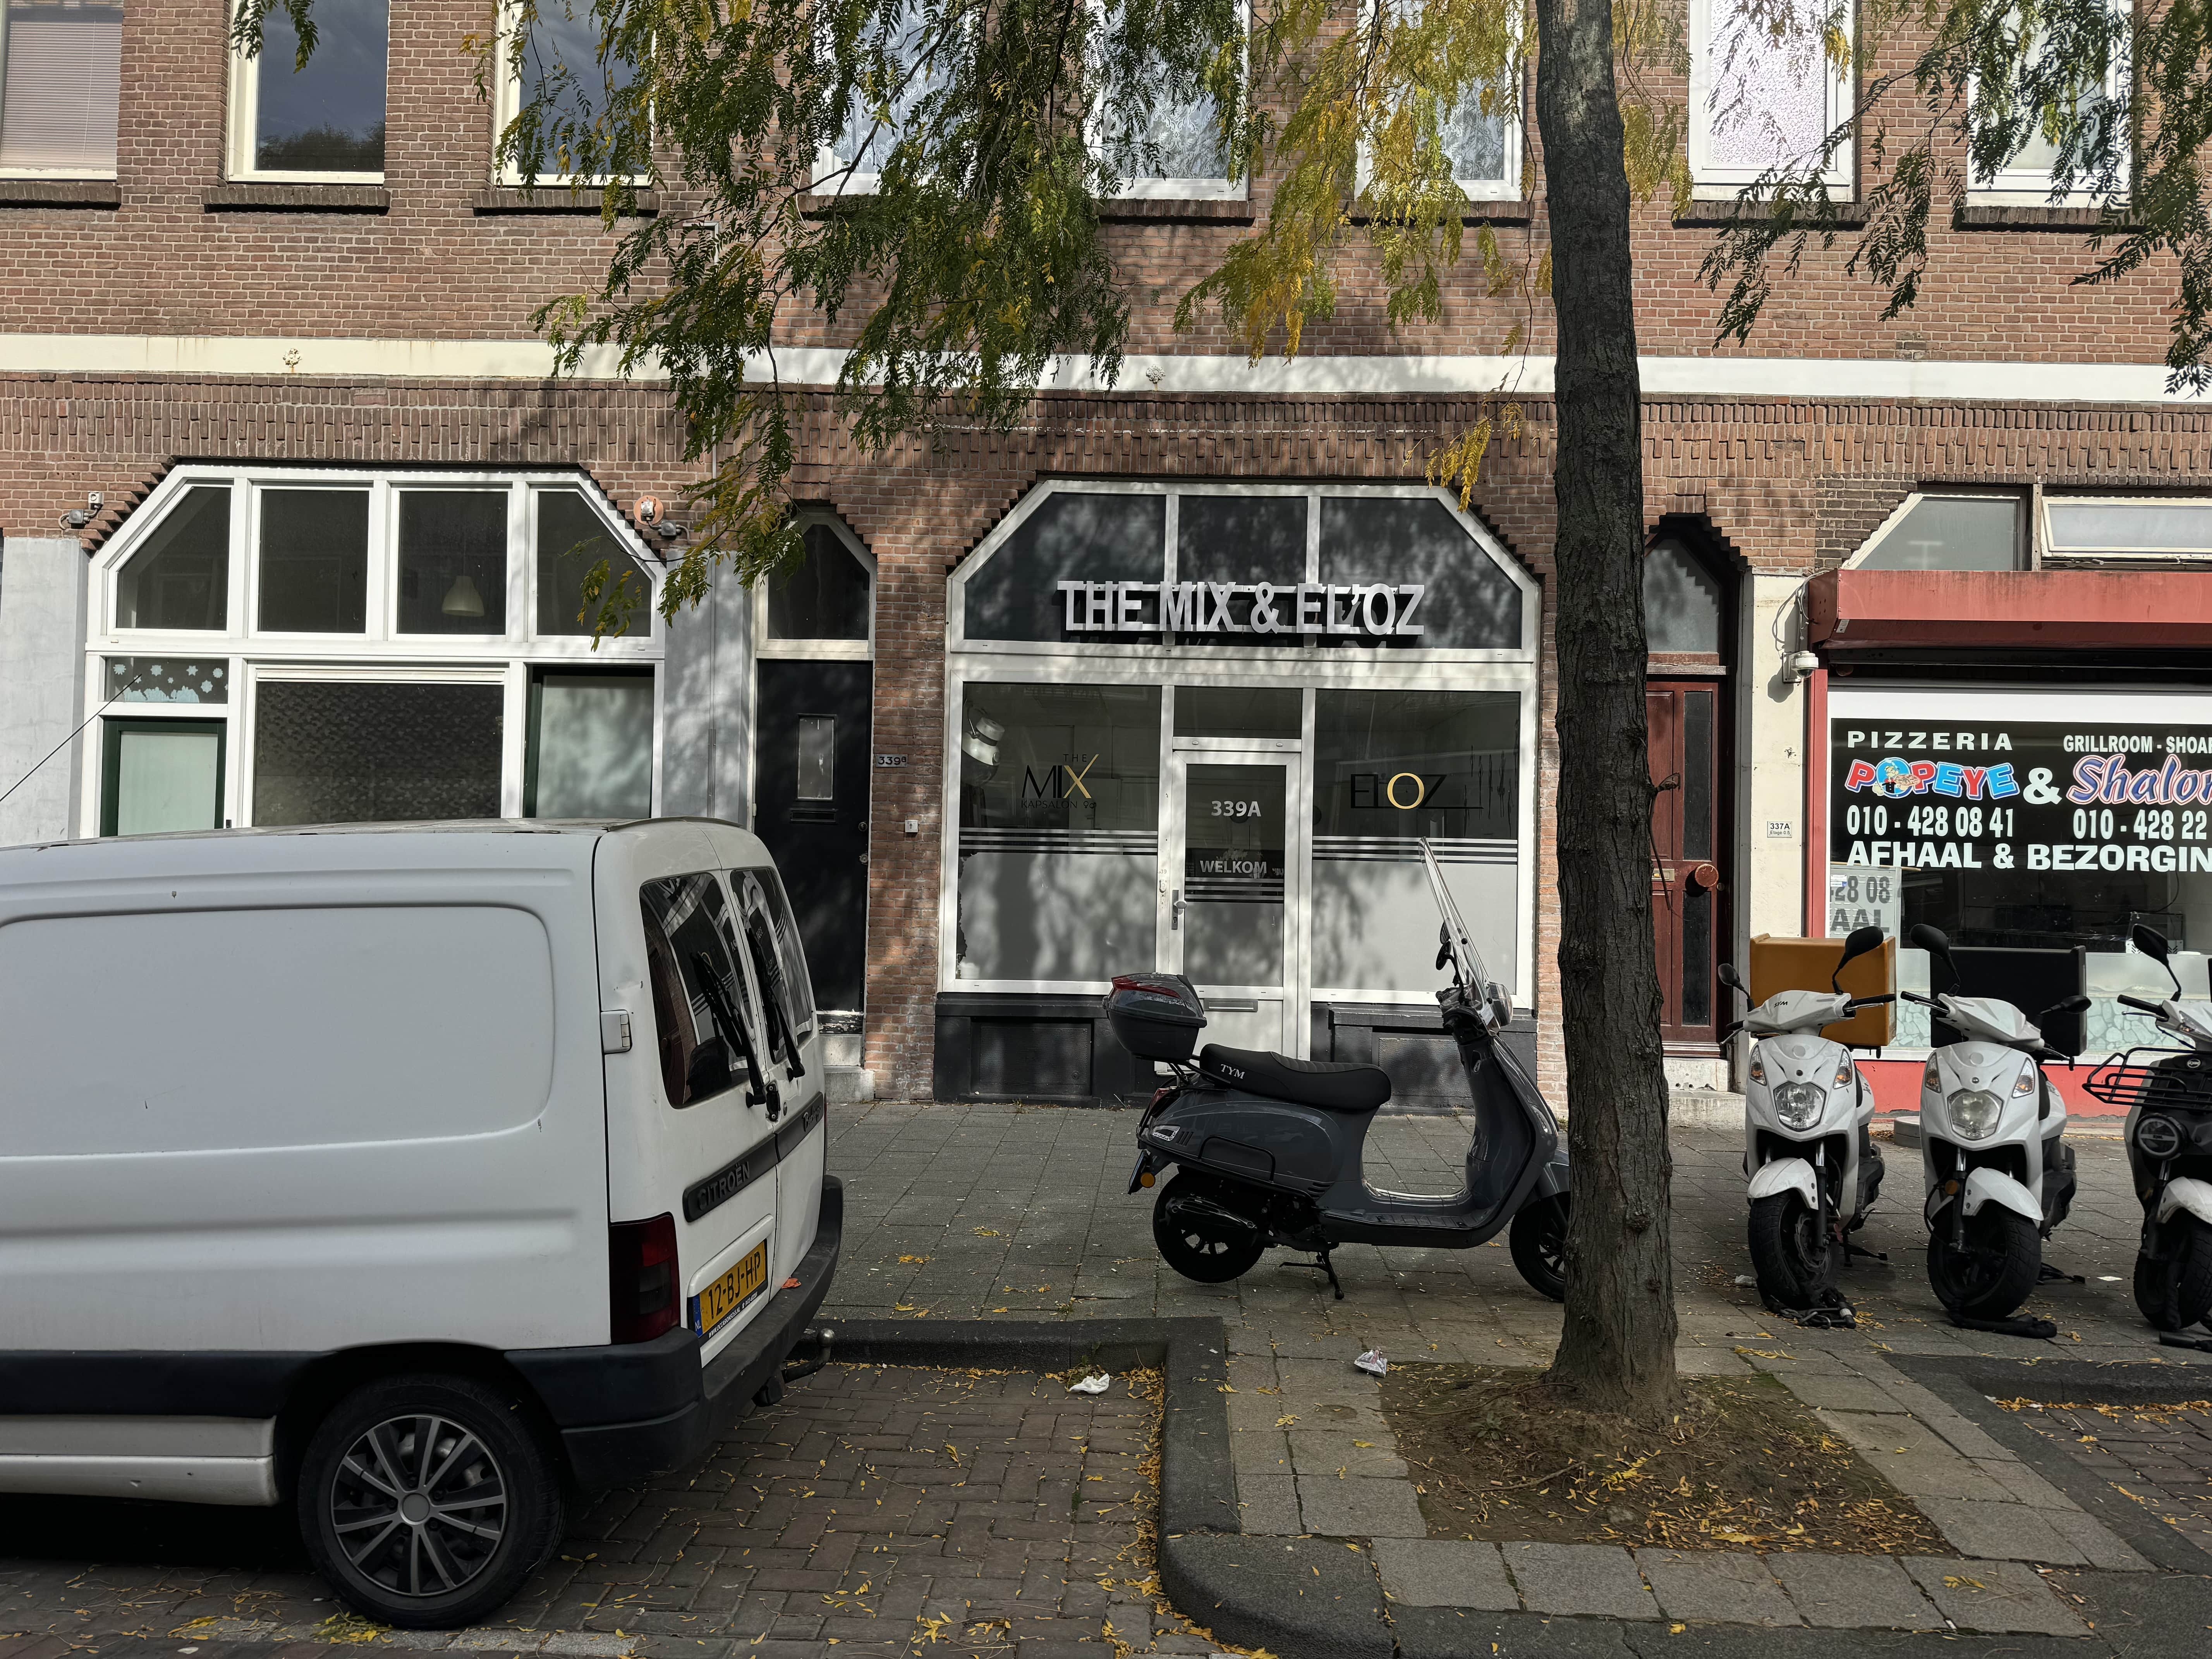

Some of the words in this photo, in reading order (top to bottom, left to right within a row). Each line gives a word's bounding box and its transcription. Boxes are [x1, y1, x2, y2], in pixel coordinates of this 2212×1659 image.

[1057, 580, 1143, 631] THE
[1160, 581, 1236, 632] MIX
[1250, 581, 1279, 634] &
[1848, 731, 2012, 750] PIZZERIA
[2063, 735, 2153, 753] GRILLROOM
[1063, 754, 1087, 762] THE
[1022, 754, 1099, 799] MIX
[1844, 756, 2020, 800] POPEYE
[2023, 767, 2063, 805] &
[1021, 800, 1077, 809] KAPSALON
[1211, 800, 1261, 817] 339A
[1847, 805, 1887, 836] 010
[1908, 805, 1948, 837] 428
[1956, 806, 1982, 837] 08
[1989, 807, 2013, 838] 41
[2073, 809, 2114, 840] 010
[2133, 809, 2174, 840] 428
[2182, 810, 2207, 840] 22
[1846, 841, 1982, 868] AFHAAL
[1993, 843, 2015, 869] &
[1200, 860, 1267, 874] WELKOM
[1221, 1064, 1245, 1079] TYM
[697, 1161, 750, 1211] CITROËN
[708, 1251, 760, 1320] 12-BJ-HP
[695, 1319, 701, 1331] NL
